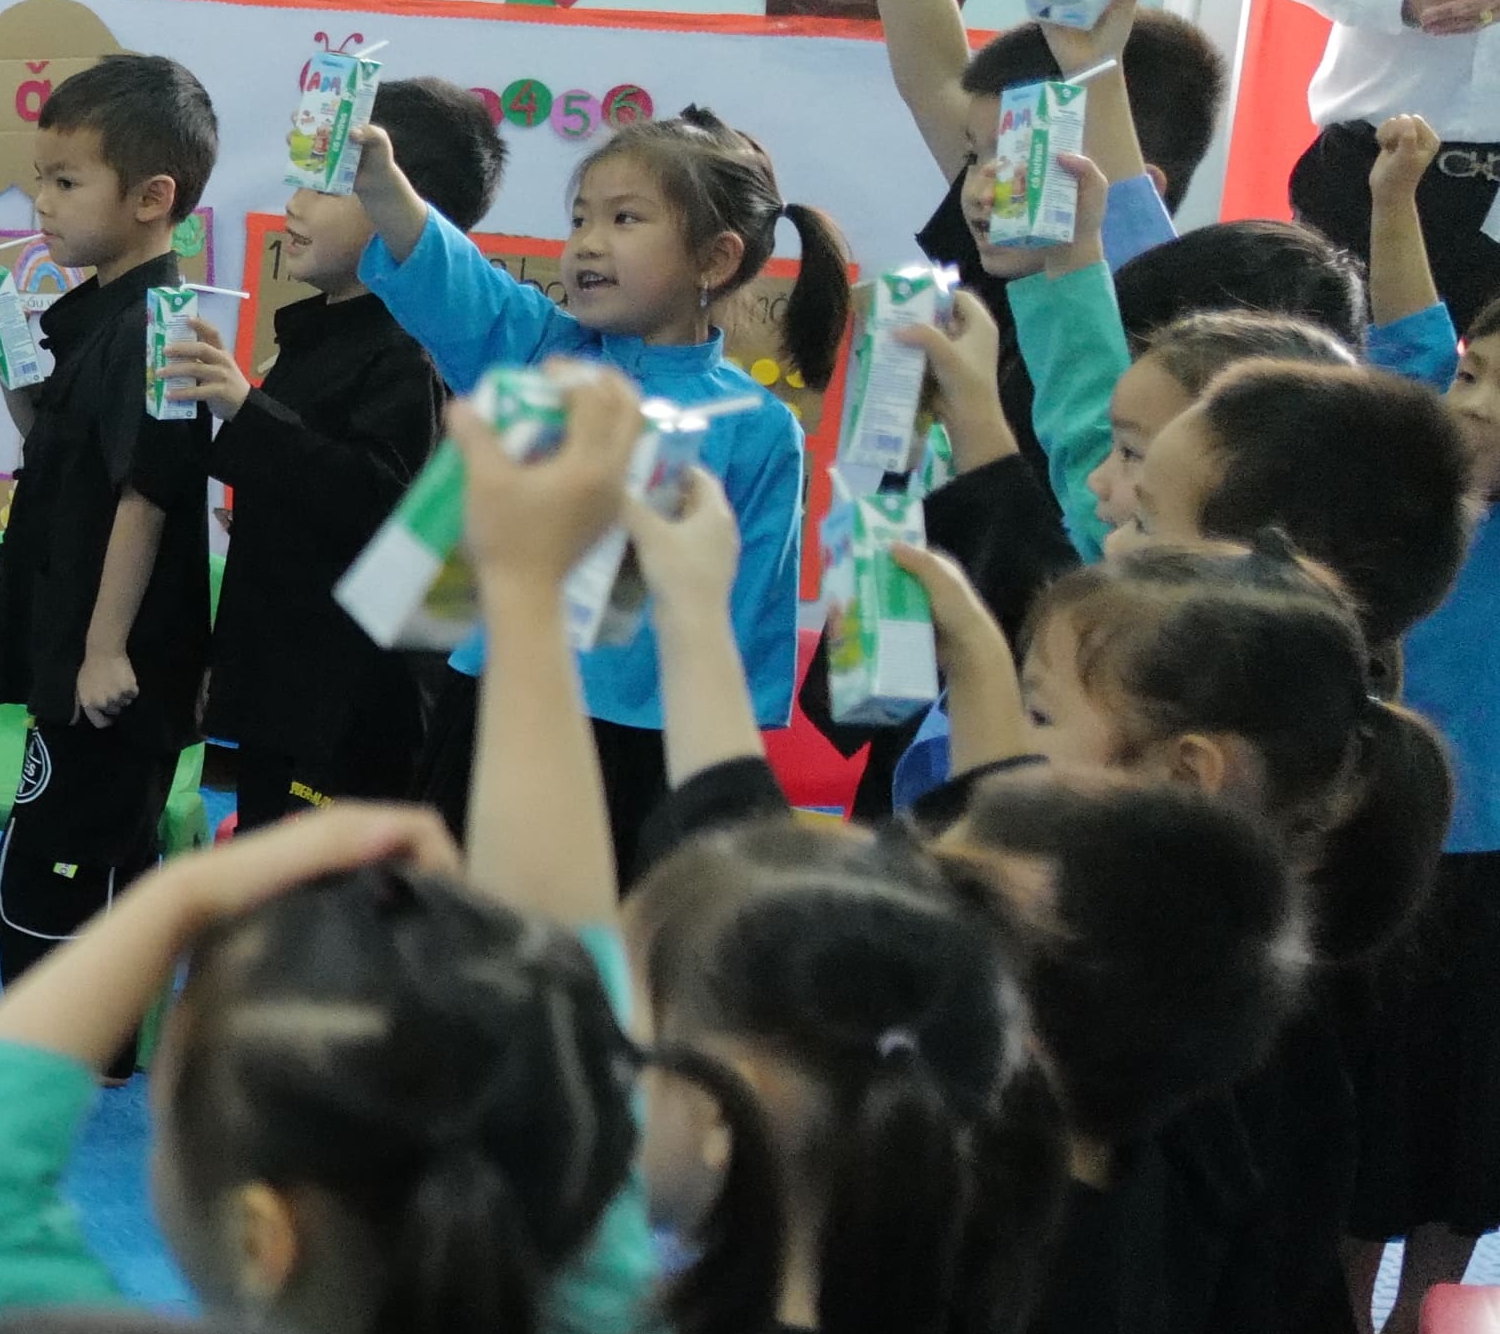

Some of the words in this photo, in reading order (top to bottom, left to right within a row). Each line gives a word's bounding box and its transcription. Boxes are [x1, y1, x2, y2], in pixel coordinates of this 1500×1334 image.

[306, 71, 342, 96] ADM
[509, 80, 538, 126] 4
[564, 94, 591, 136] 5
[609, 87, 646, 127] 6
